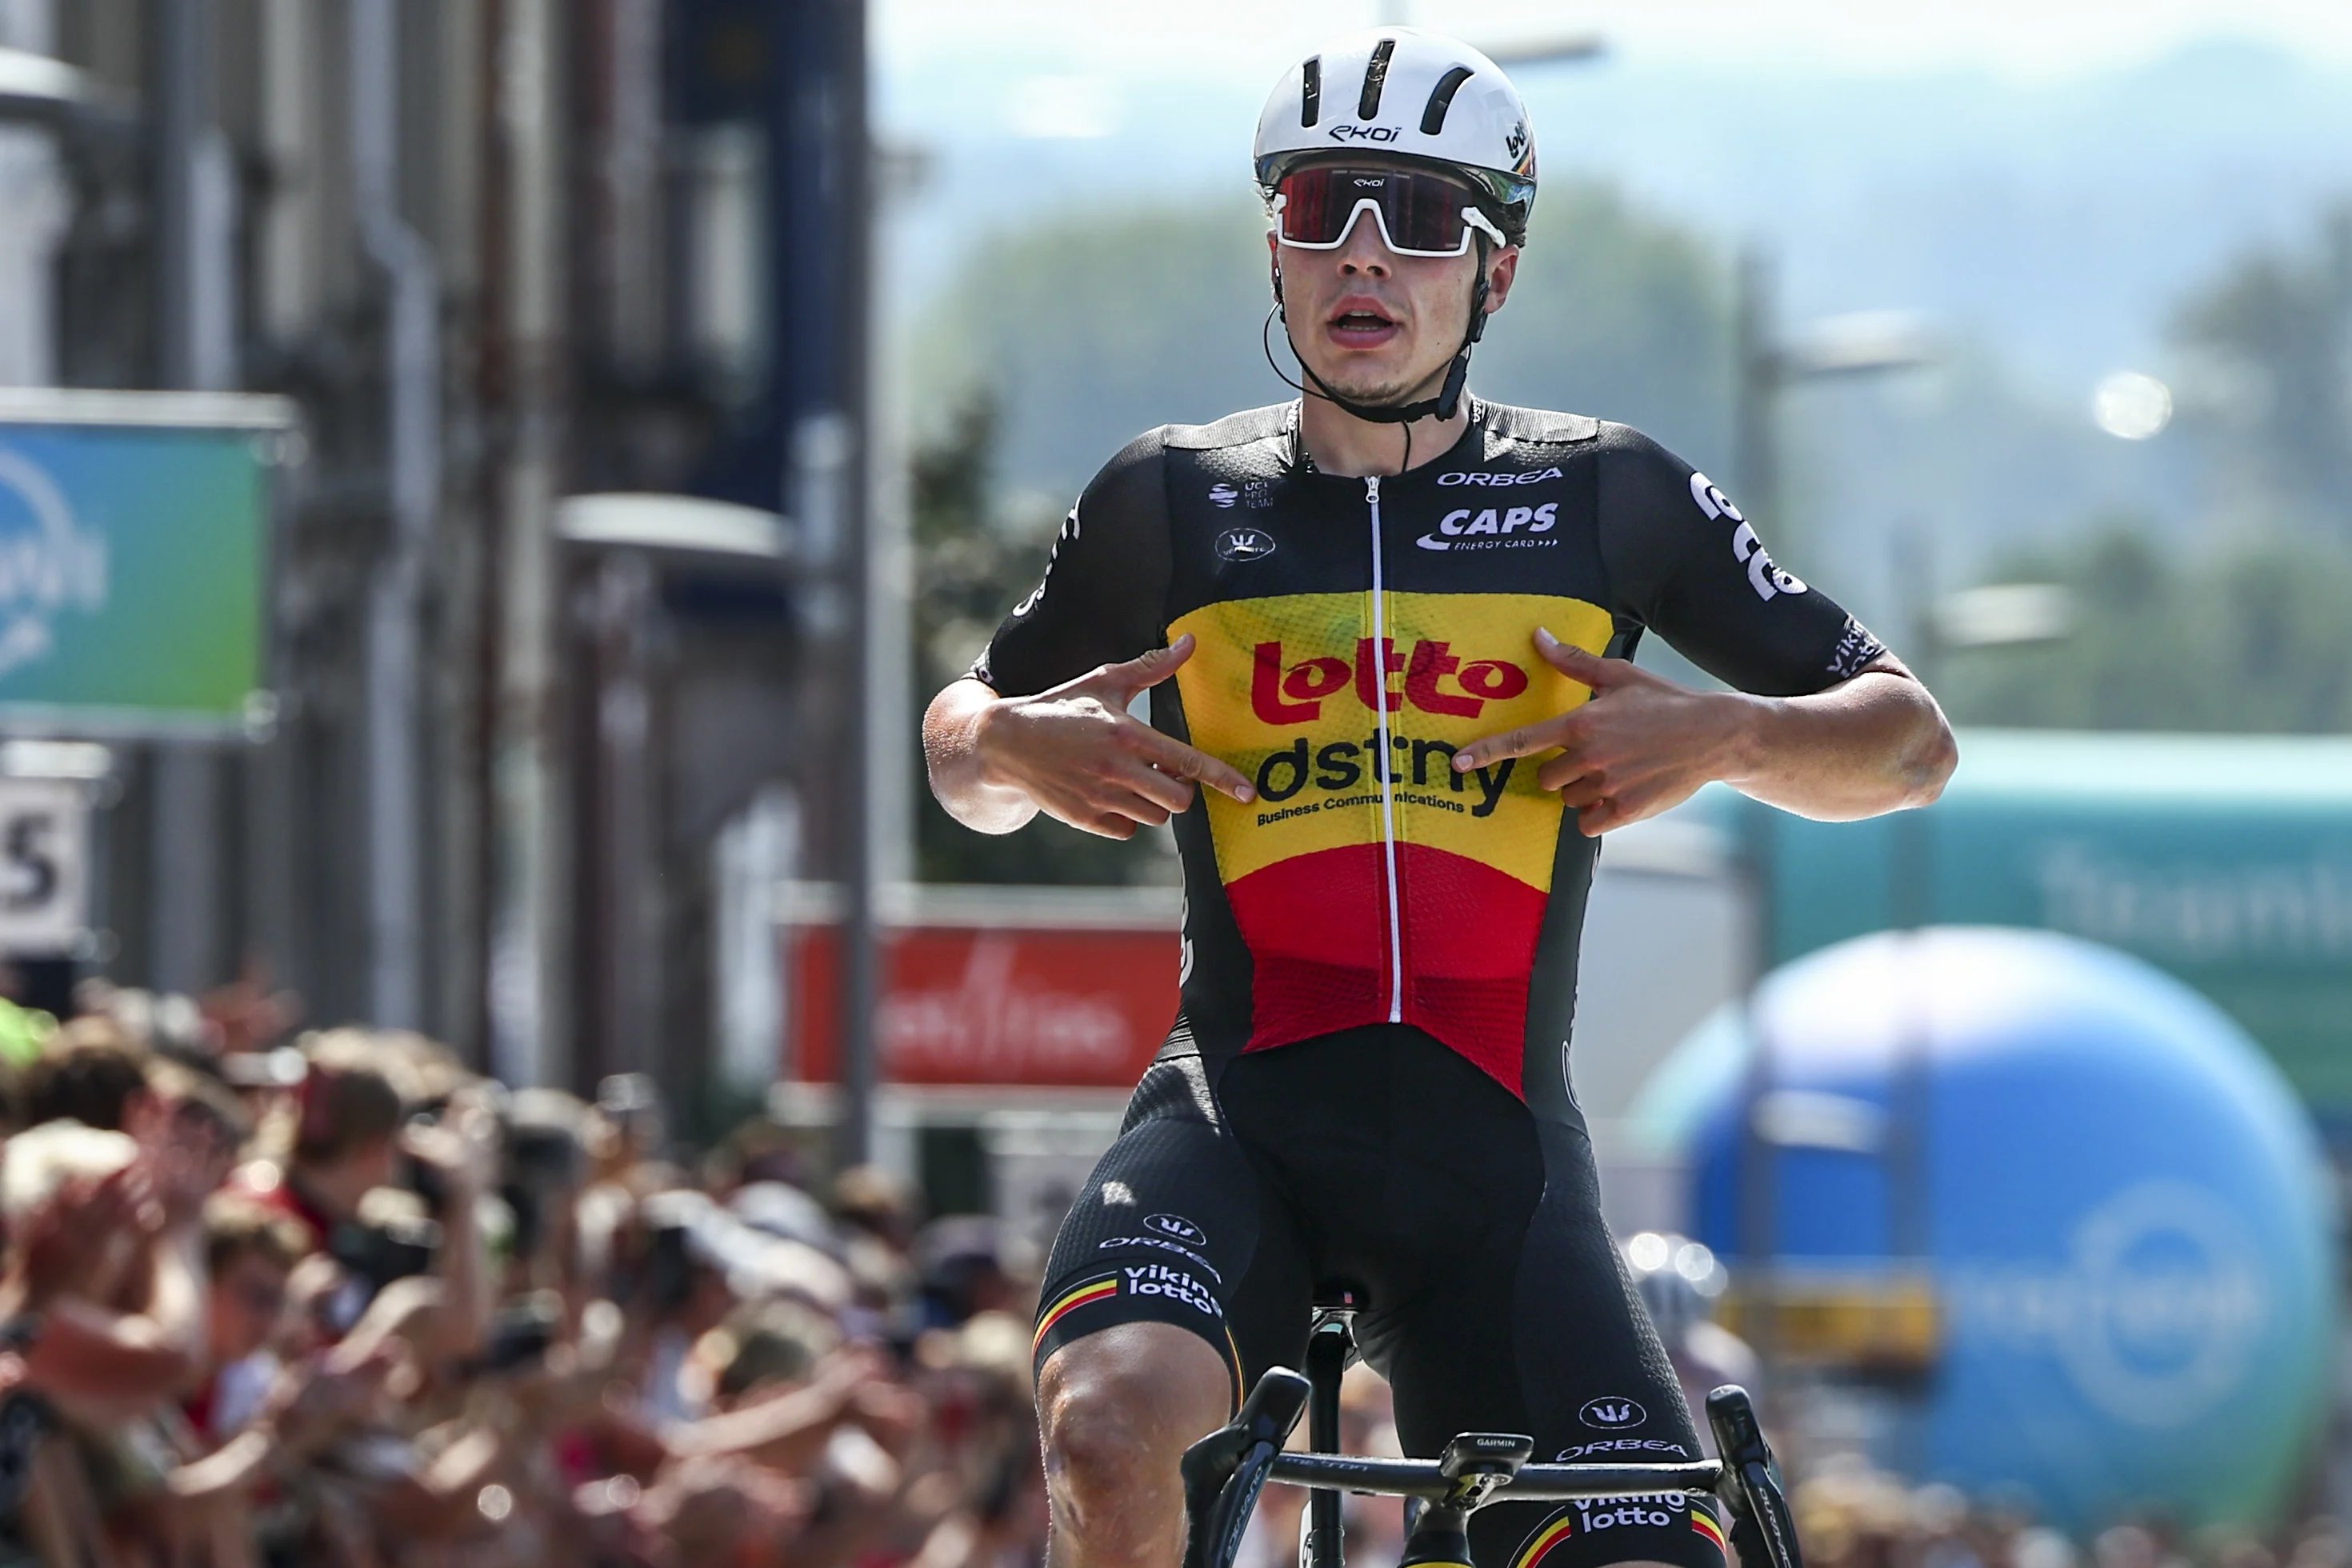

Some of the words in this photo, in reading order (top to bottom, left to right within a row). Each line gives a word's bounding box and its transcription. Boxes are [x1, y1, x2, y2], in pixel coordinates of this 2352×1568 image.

[1245, 482, 1268, 490] UCI
[1437, 466, 1563, 486] ORBEA
[1440, 502, 1559, 536] CAPS
[1454, 540, 1501, 551] ENERGY
[1505, 539, 1534, 548] CARD
[1256, 727, 1517, 818] dstny
[1257, 802, 1320, 827] Business
[1324, 791, 1465, 814] Communications
[1124, 1264, 1223, 1318] viking
[1130, 1278, 1213, 1315] lotto
[1477, 1438, 1516, 1448] GARMIN
[1555, 1438, 1689, 1462] ORBEA
[1582, 1506, 1670, 1534] lotto
